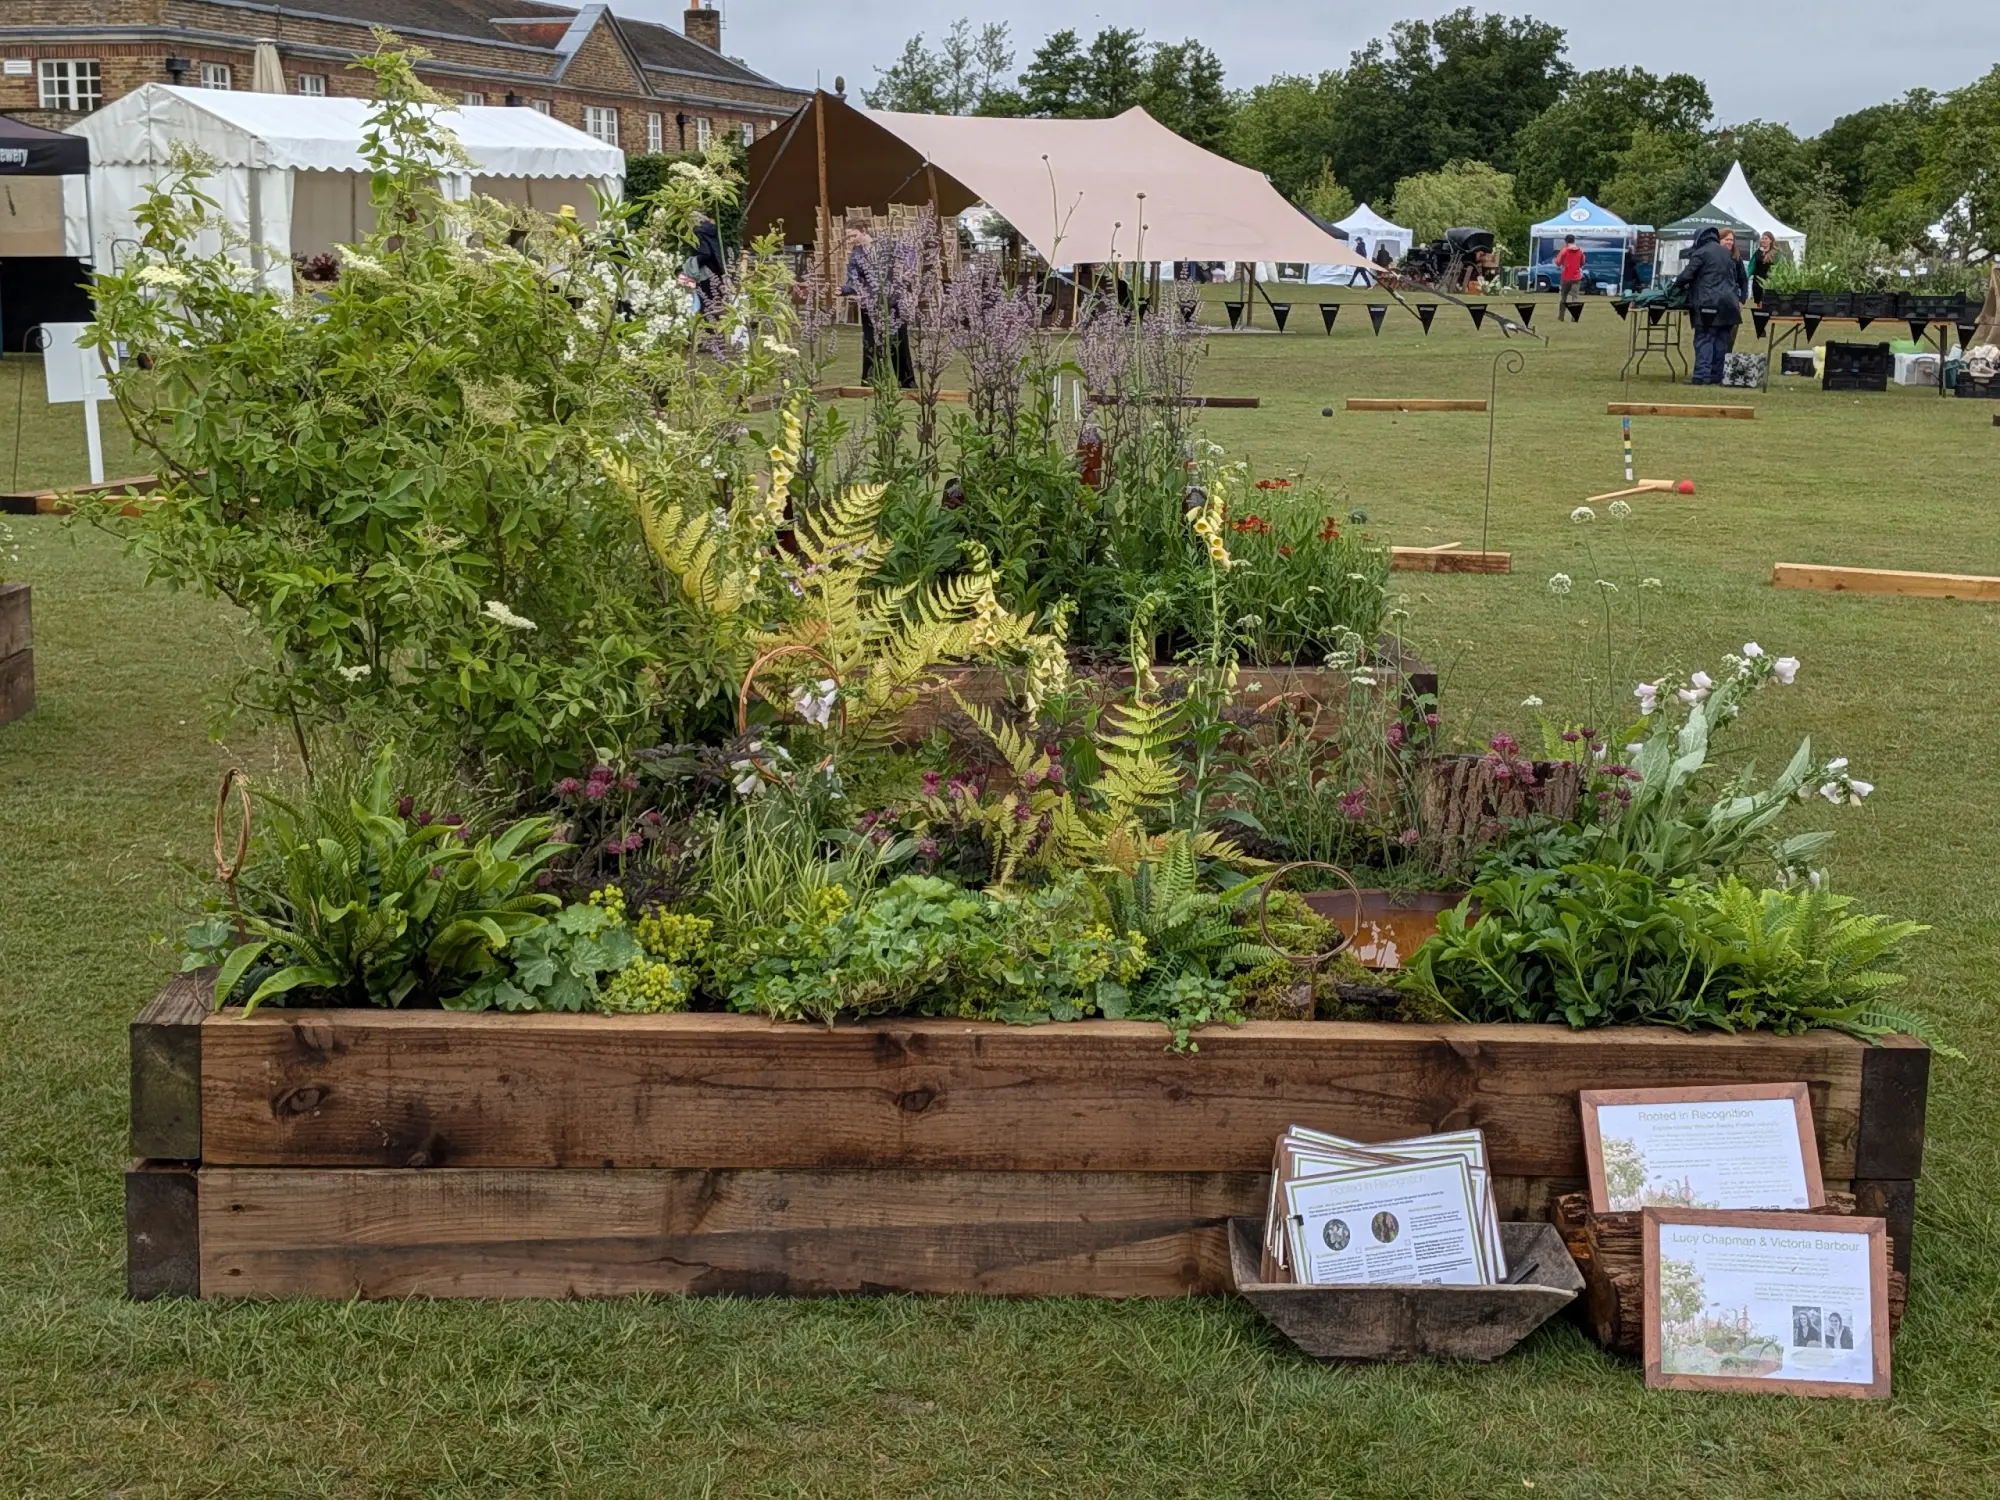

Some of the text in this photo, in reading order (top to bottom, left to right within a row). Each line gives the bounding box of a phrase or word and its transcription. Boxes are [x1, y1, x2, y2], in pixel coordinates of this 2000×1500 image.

[0, 148, 29, 168] ewery
[1638, 1108, 1754, 1122] Rooted in Recognition
[1672, 1232, 1860, 1252] Lucy Chapman & Victoria Barbour
